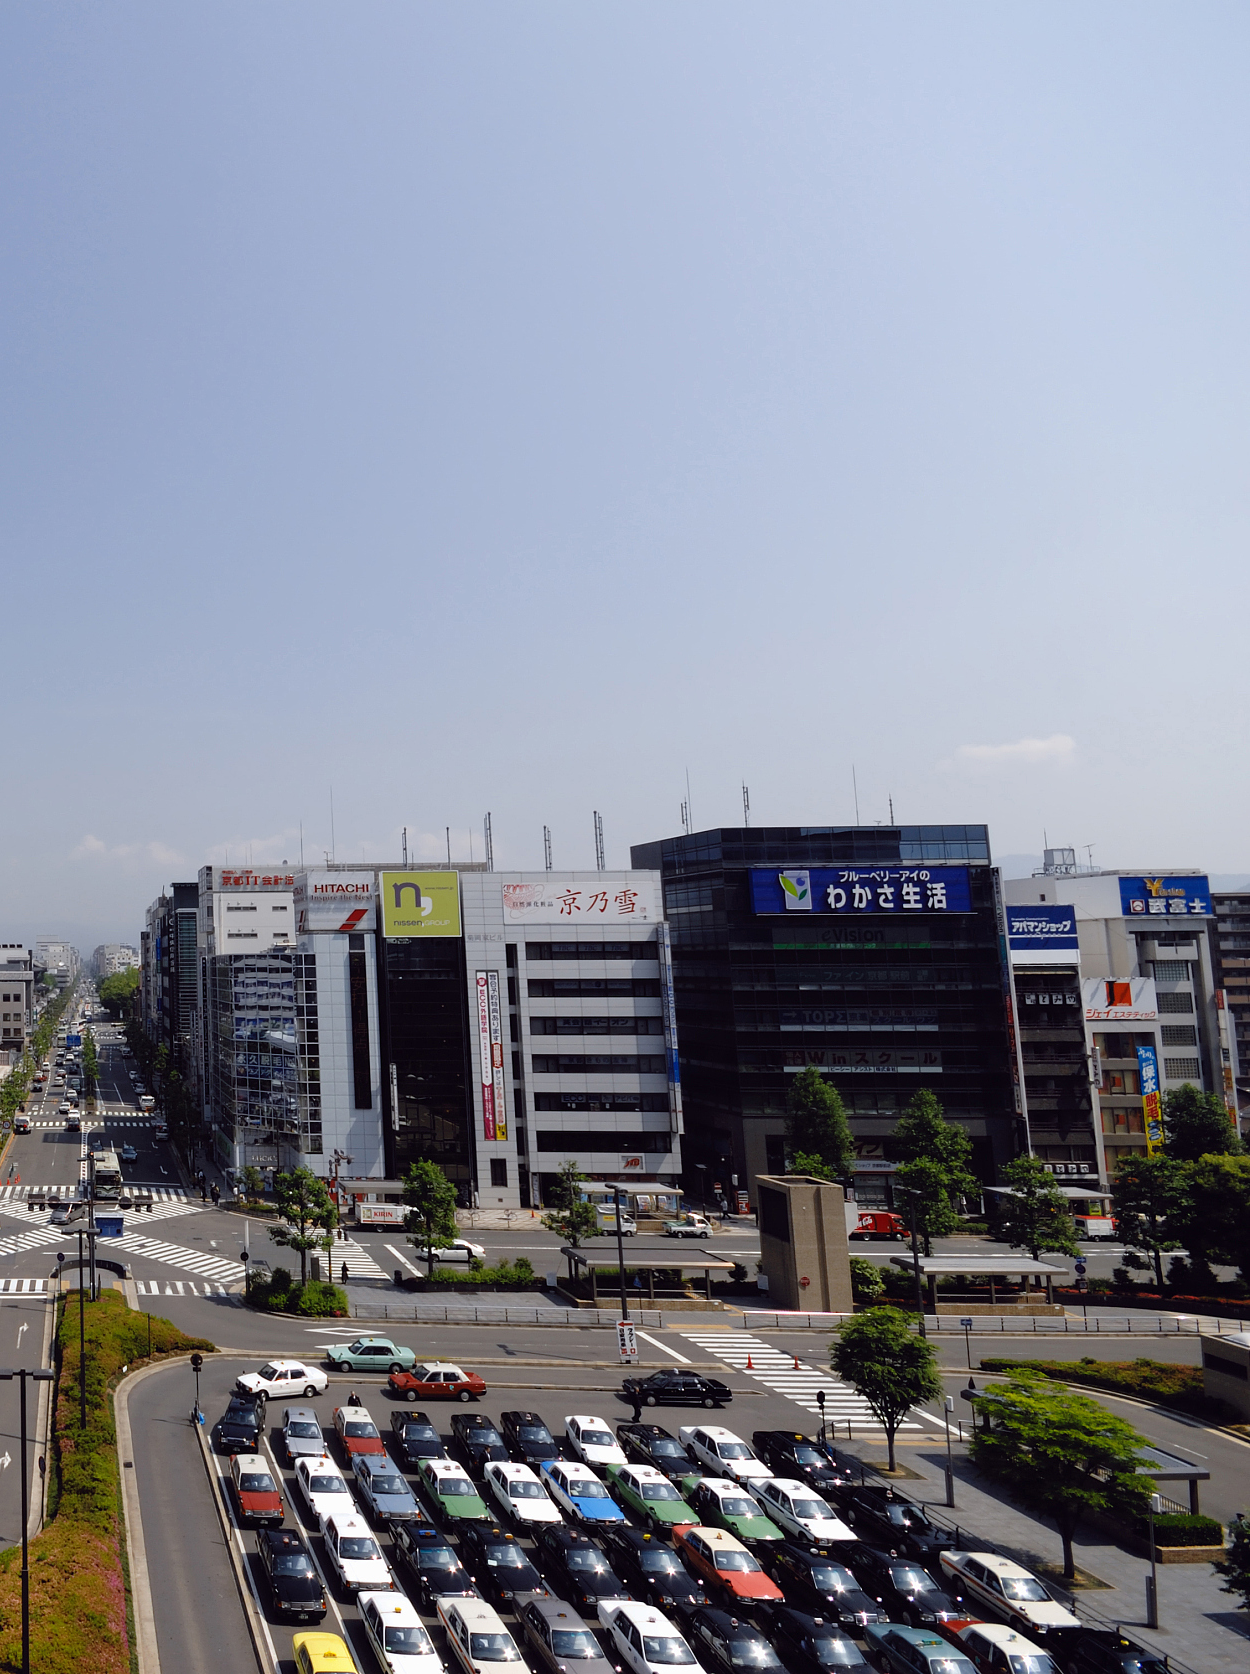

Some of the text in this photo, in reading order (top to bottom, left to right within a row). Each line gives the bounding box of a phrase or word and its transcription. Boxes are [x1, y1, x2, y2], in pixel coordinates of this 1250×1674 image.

[838, 870, 930, 882] ブルーベリーアイの
[314, 884, 369, 893] HITACHI
[556, 889, 638, 915] 京乃雪
[826, 883, 947, 909] わかさ生活
[1148, 898, 1206, 913] 武富士
[1011, 920, 1071, 933] アパマンショップ
[822, 928, 885, 942] eVision
[1086, 1009, 1113, 1018] ジェイ
[1142, 1065, 1157, 1093] 保水
[1145, 1092, 1160, 1120] 脱毛
